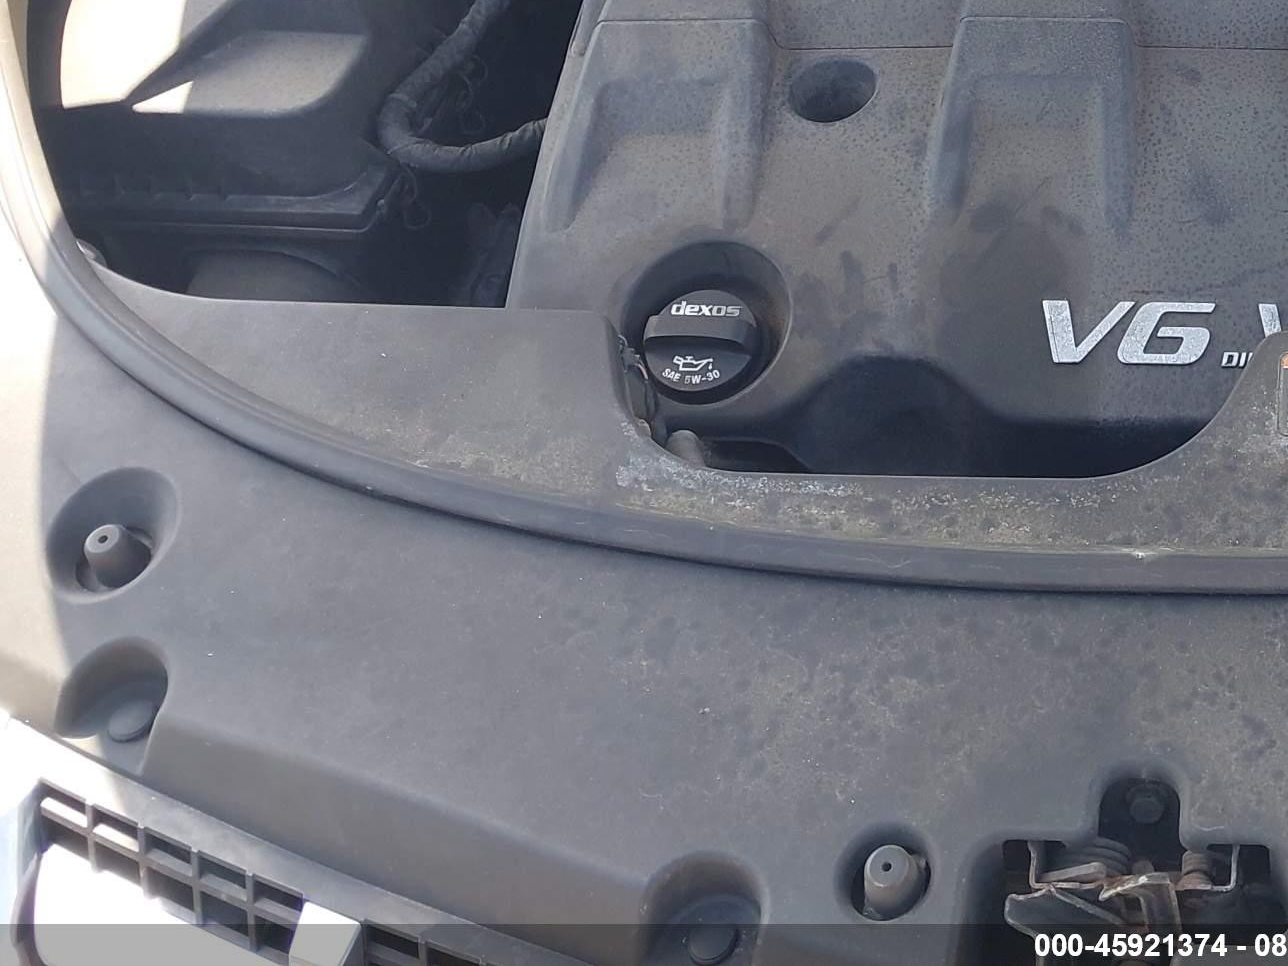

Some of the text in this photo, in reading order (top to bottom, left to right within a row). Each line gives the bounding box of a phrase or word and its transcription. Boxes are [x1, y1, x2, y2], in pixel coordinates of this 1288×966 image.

[671, 300, 742, 317] dexos
[1042, 299, 1216, 364] V6
[662, 368, 721, 384] SAE 5W-30
